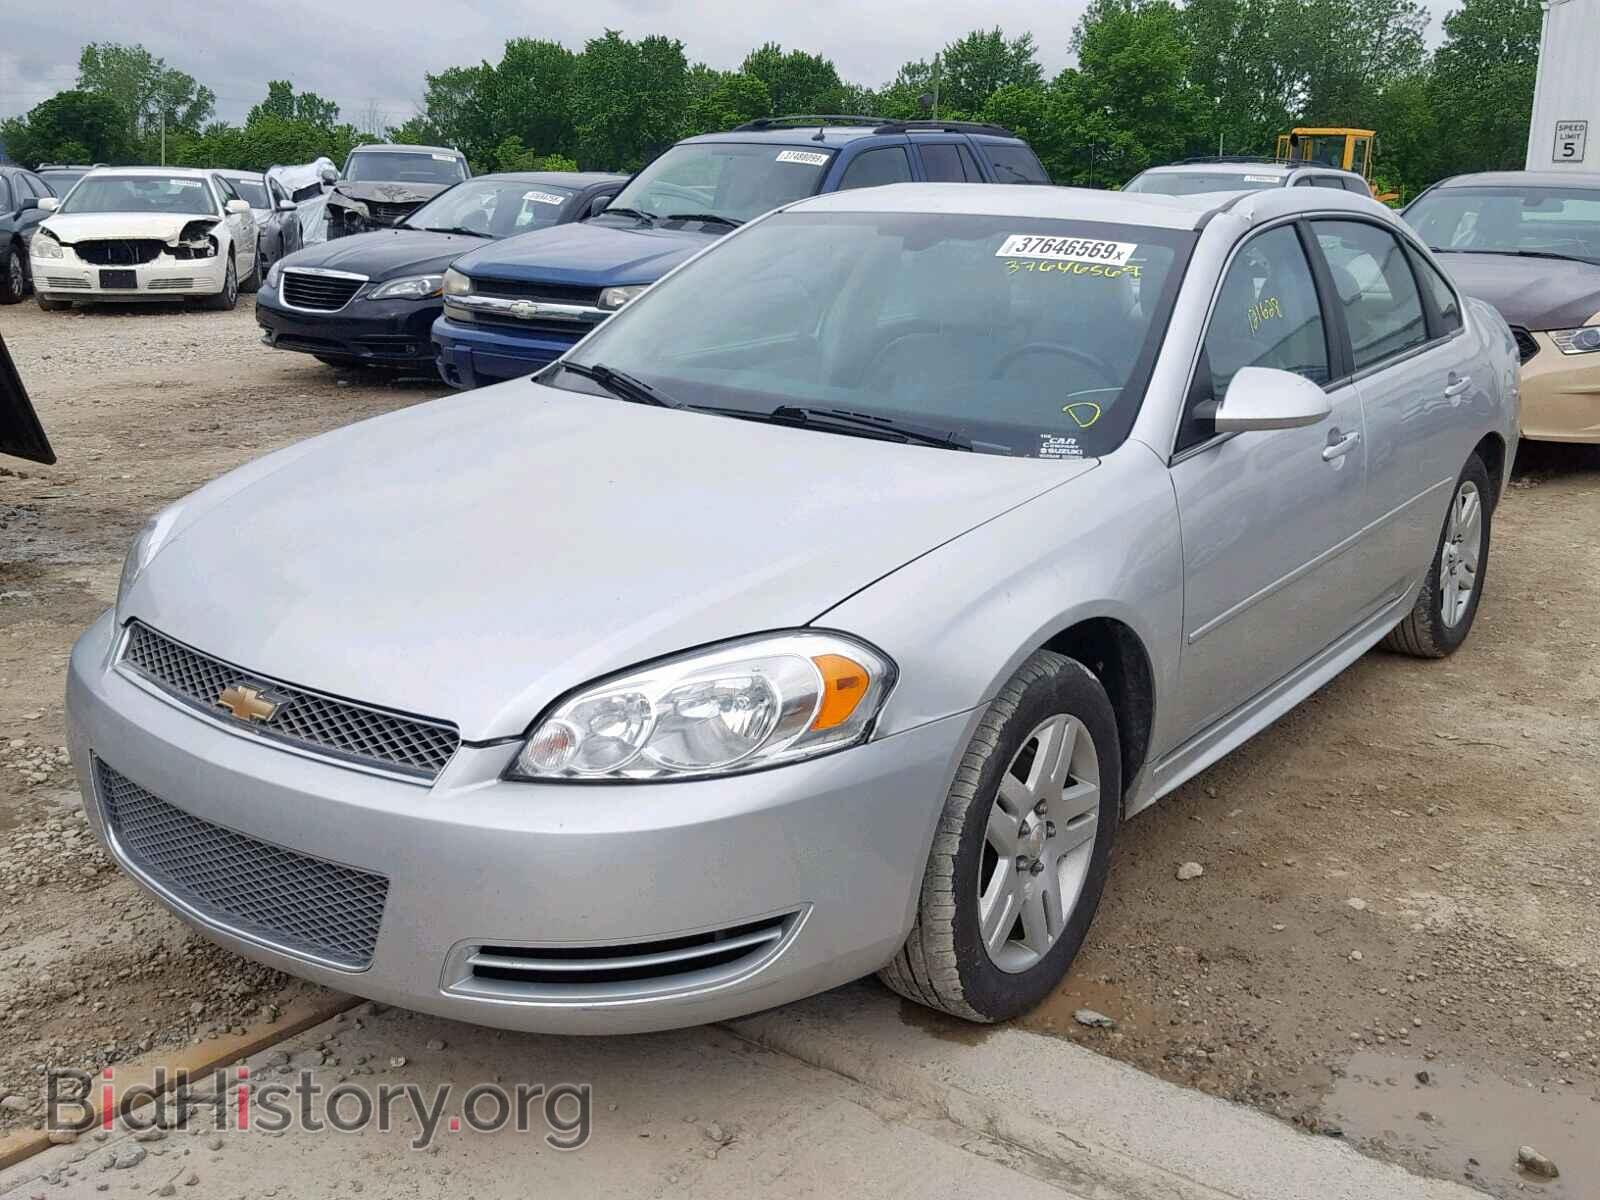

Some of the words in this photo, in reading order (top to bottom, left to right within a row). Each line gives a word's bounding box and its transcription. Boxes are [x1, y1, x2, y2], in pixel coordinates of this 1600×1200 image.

[1558, 124, 1585, 132] SPEED
[1559, 132, 1581, 140] LIMIT
[1562, 142, 1575, 157] 5
